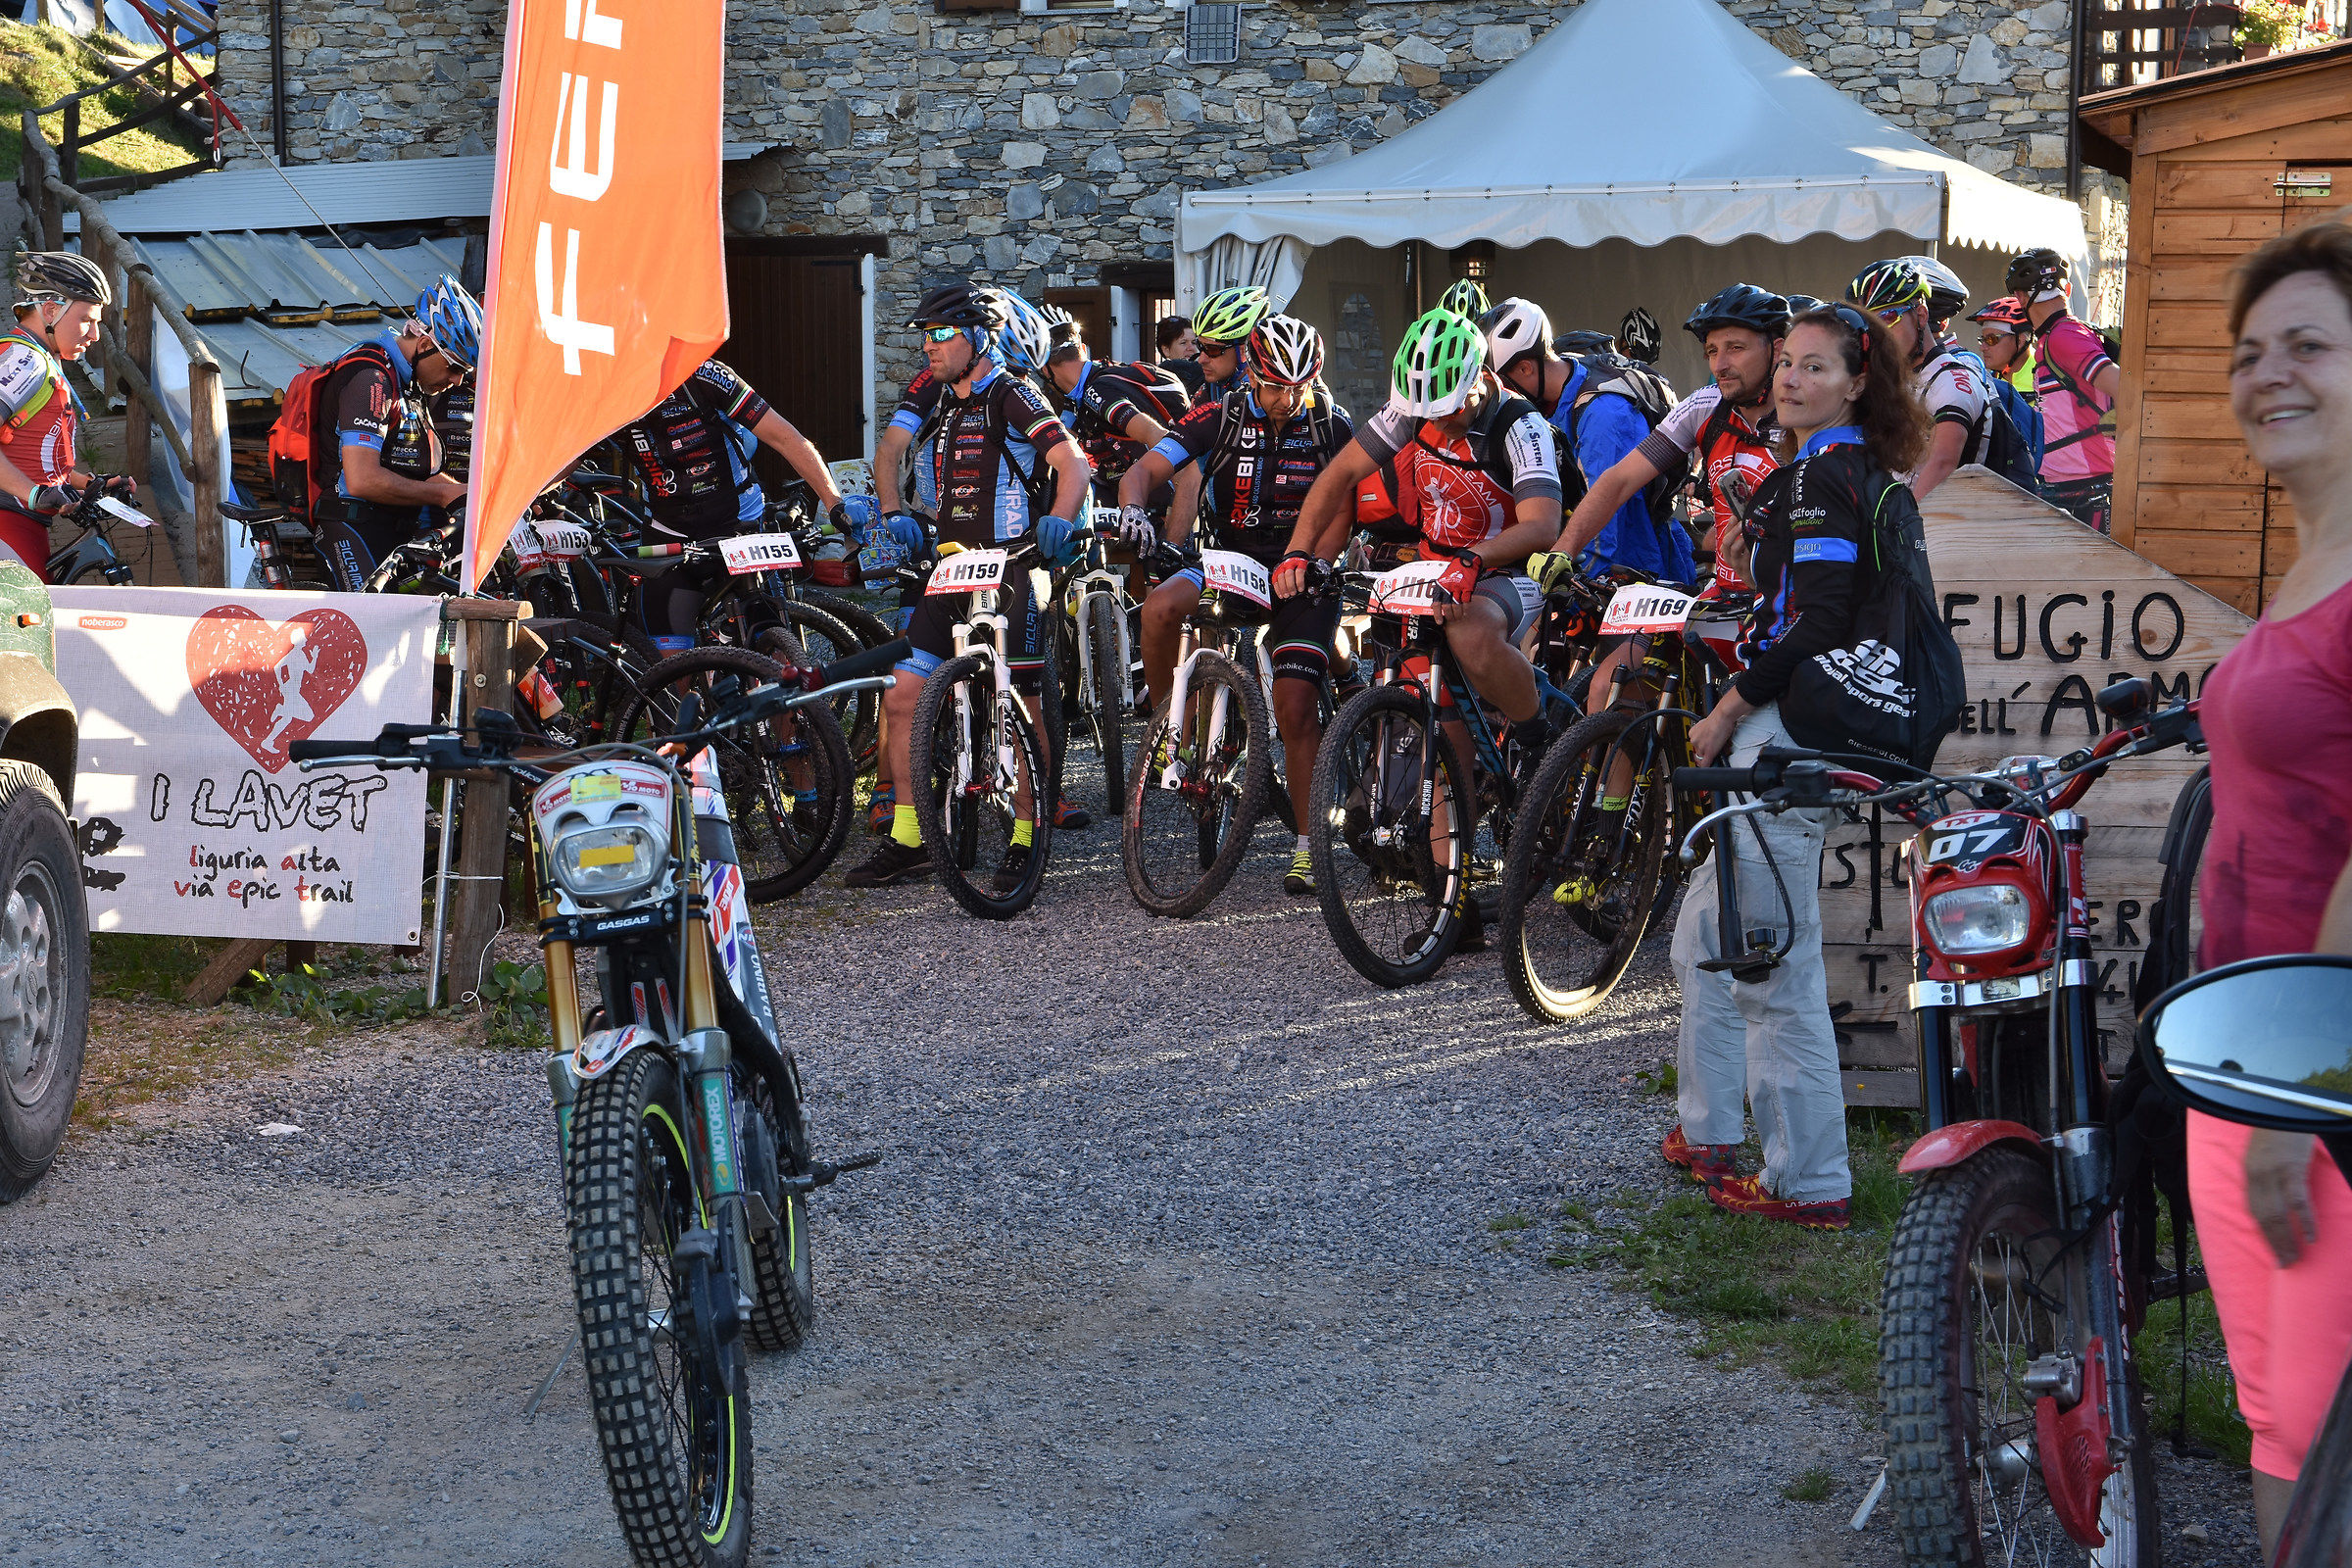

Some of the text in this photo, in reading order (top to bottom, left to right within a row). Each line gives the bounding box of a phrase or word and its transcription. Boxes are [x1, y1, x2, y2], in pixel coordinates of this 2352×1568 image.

[558, 530, 589, 549] H153
[748, 544, 794, 561] H155
[954, 563, 1000, 580] H159
[1230, 564, 1267, 595] H158
[81, 616, 125, 628] noberasco
[1634, 598, 1688, 618] H169
[150, 768, 389, 833] I LAVET
[638, 786, 661, 796] MOTO
[1420, 779, 1433, 816] ROCKSHOX
[1944, 813, 1986, 829] TXT
[1928, 827, 2012, 864] 07
[188, 845, 341, 882] liguria alta
[173, 876, 355, 908] via epic trail
[1453, 852, 1470, 919] MAXXIS
[596, 914, 651, 931] GASGAS
[749, 953, 774, 1018] RABINO
[705, 1086, 728, 1162] MOTOREX
